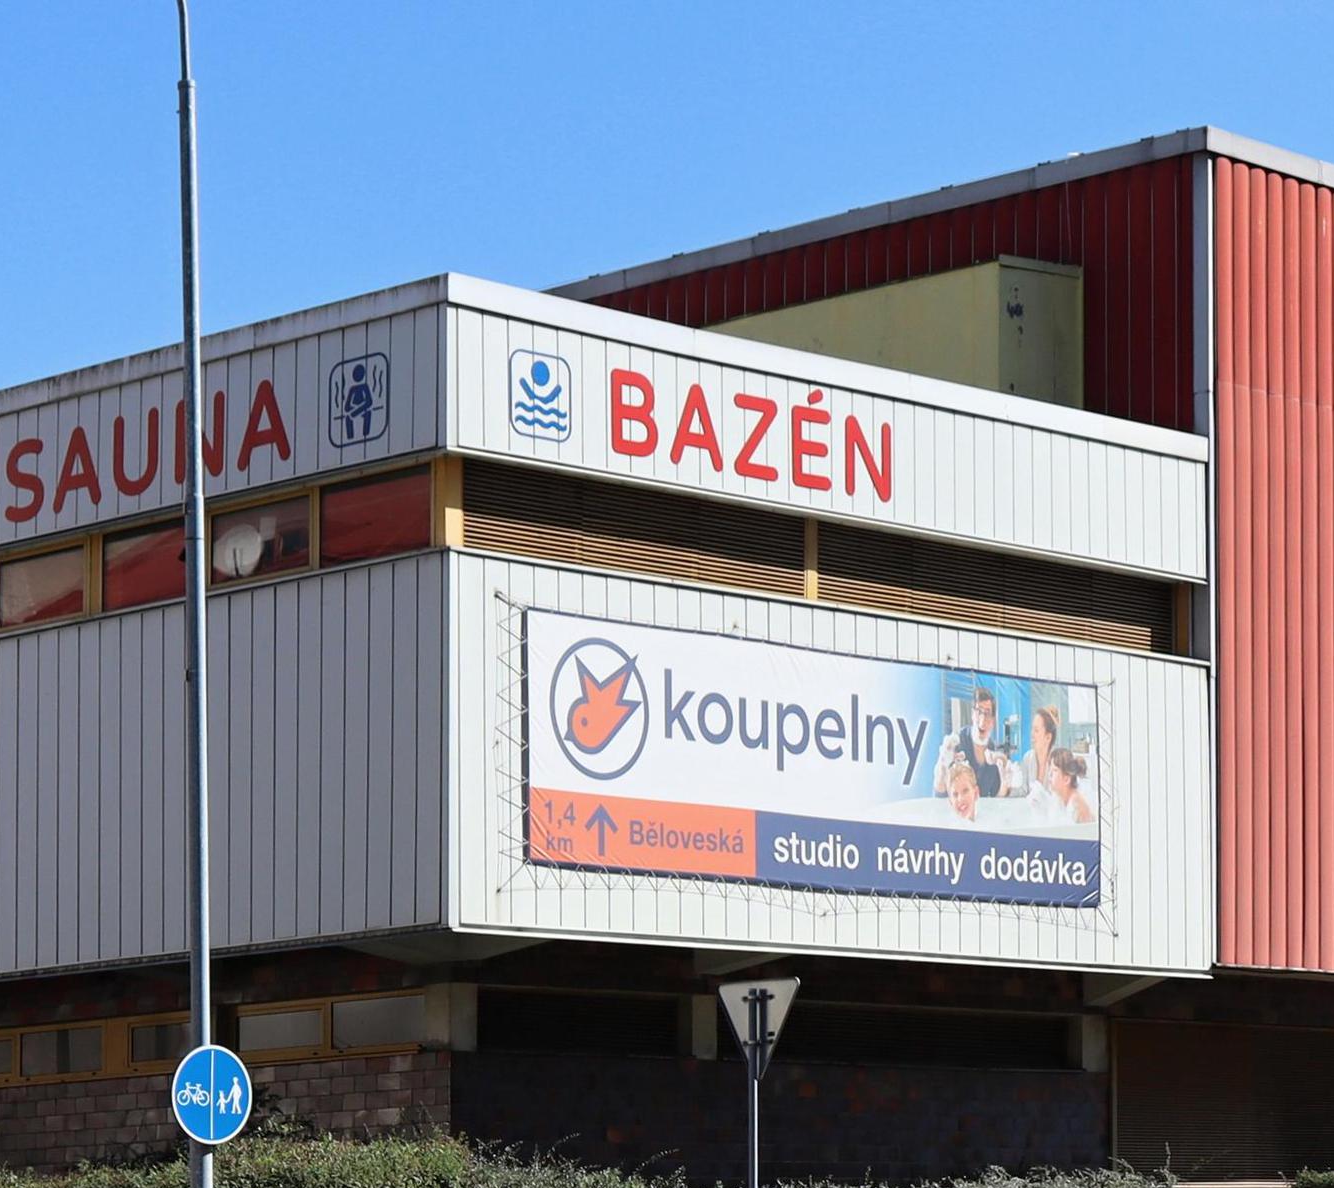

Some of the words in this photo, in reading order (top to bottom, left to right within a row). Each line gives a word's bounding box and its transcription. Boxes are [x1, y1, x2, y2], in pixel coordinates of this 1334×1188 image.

[5, 379, 292, 523] SAUNA
[610, 368, 892, 503] BAZÉN
[664, 668, 929, 786] koupelny
[544, 799, 577, 829] 1,4
[629, 818, 744, 854] Běloveská
[545, 833, 574, 853] km
[773, 831, 860, 870] studio
[877, 839, 965, 886] návrhy
[980, 847, 1087, 887] dodávka
